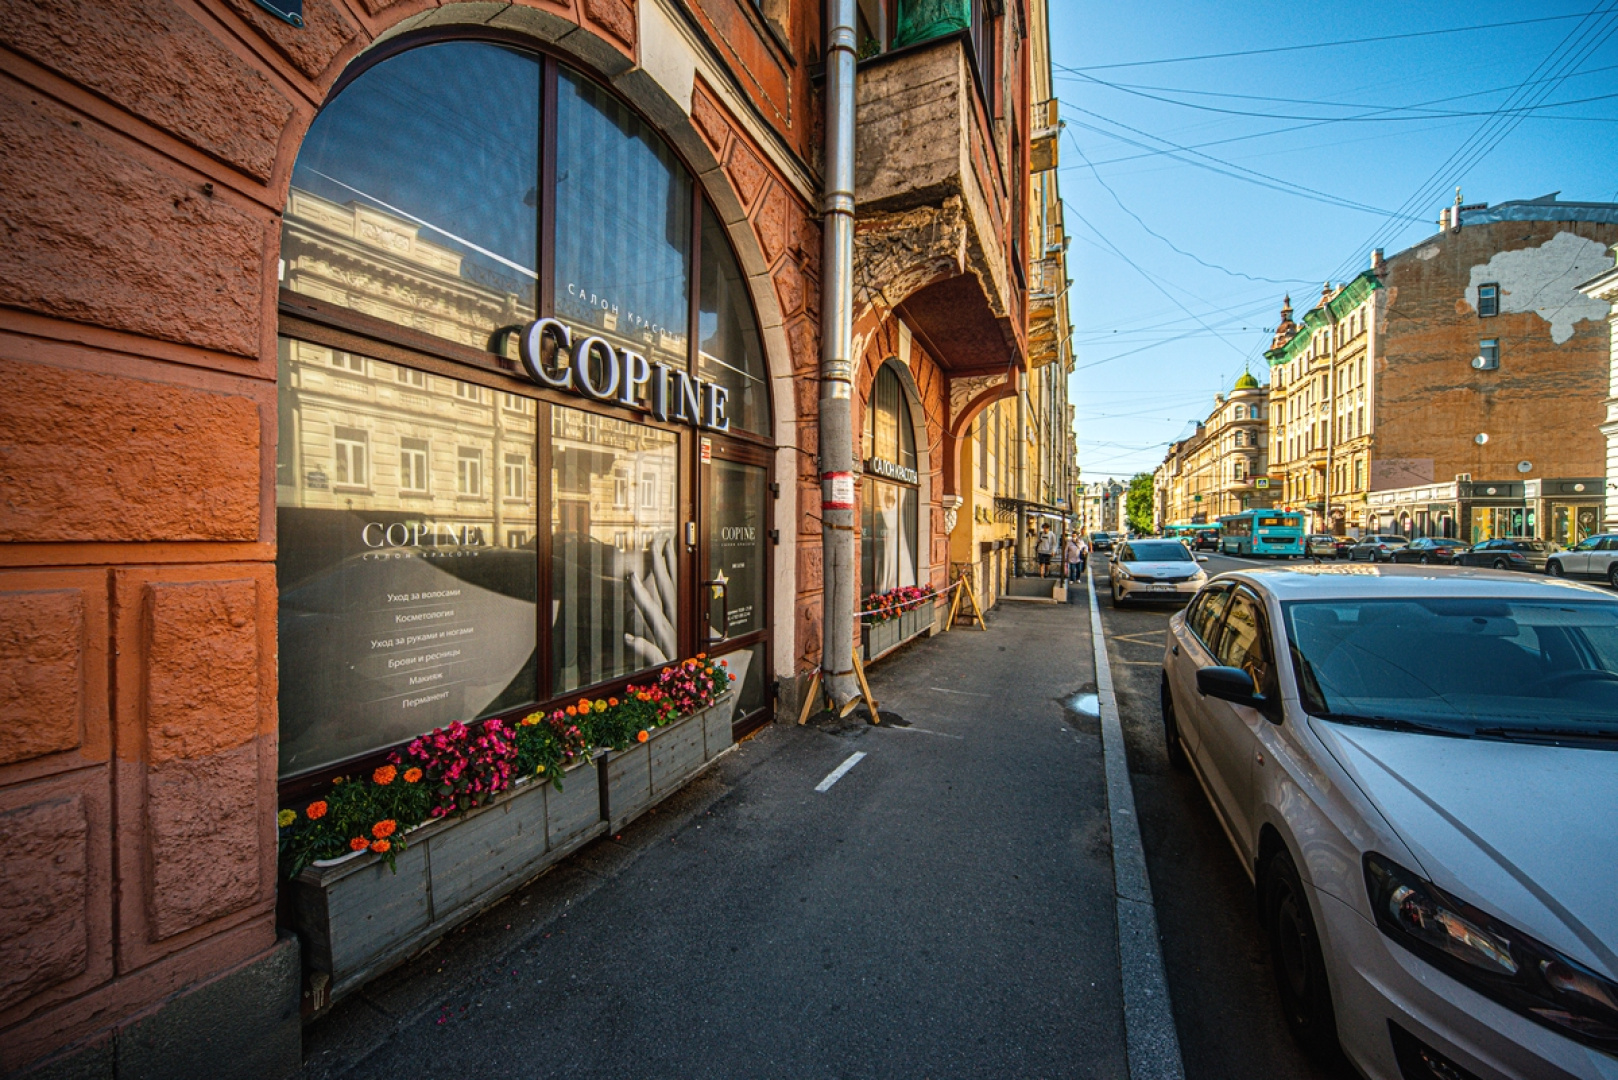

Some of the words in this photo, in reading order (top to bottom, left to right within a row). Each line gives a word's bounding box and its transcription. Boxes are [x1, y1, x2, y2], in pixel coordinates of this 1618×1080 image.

[568, 282, 619, 315] САЛОН
[628, 311, 682, 342] КРАСОТЫ
[521, 317, 730, 433] COPINE
[362, 521, 480, 548] COPINE
[721, 526, 756, 541] COPINE
[363, 553, 411, 561] САЛОН
[387, 593, 410, 603] Уход
[410, 593, 420, 601] за
[421, 588, 461, 600] волосами
[395, 609, 454, 624] Косметология
[371, 639, 394, 649] Уход
[395, 637, 405, 645] за
[406, 632, 438, 645] руками
[446, 626, 474, 637] ногами
[388, 657, 416, 669] Брови
[425, 648, 461, 663] ресницы
[409, 672, 443, 686] Макияж
[402, 691, 450, 709] Перманент
